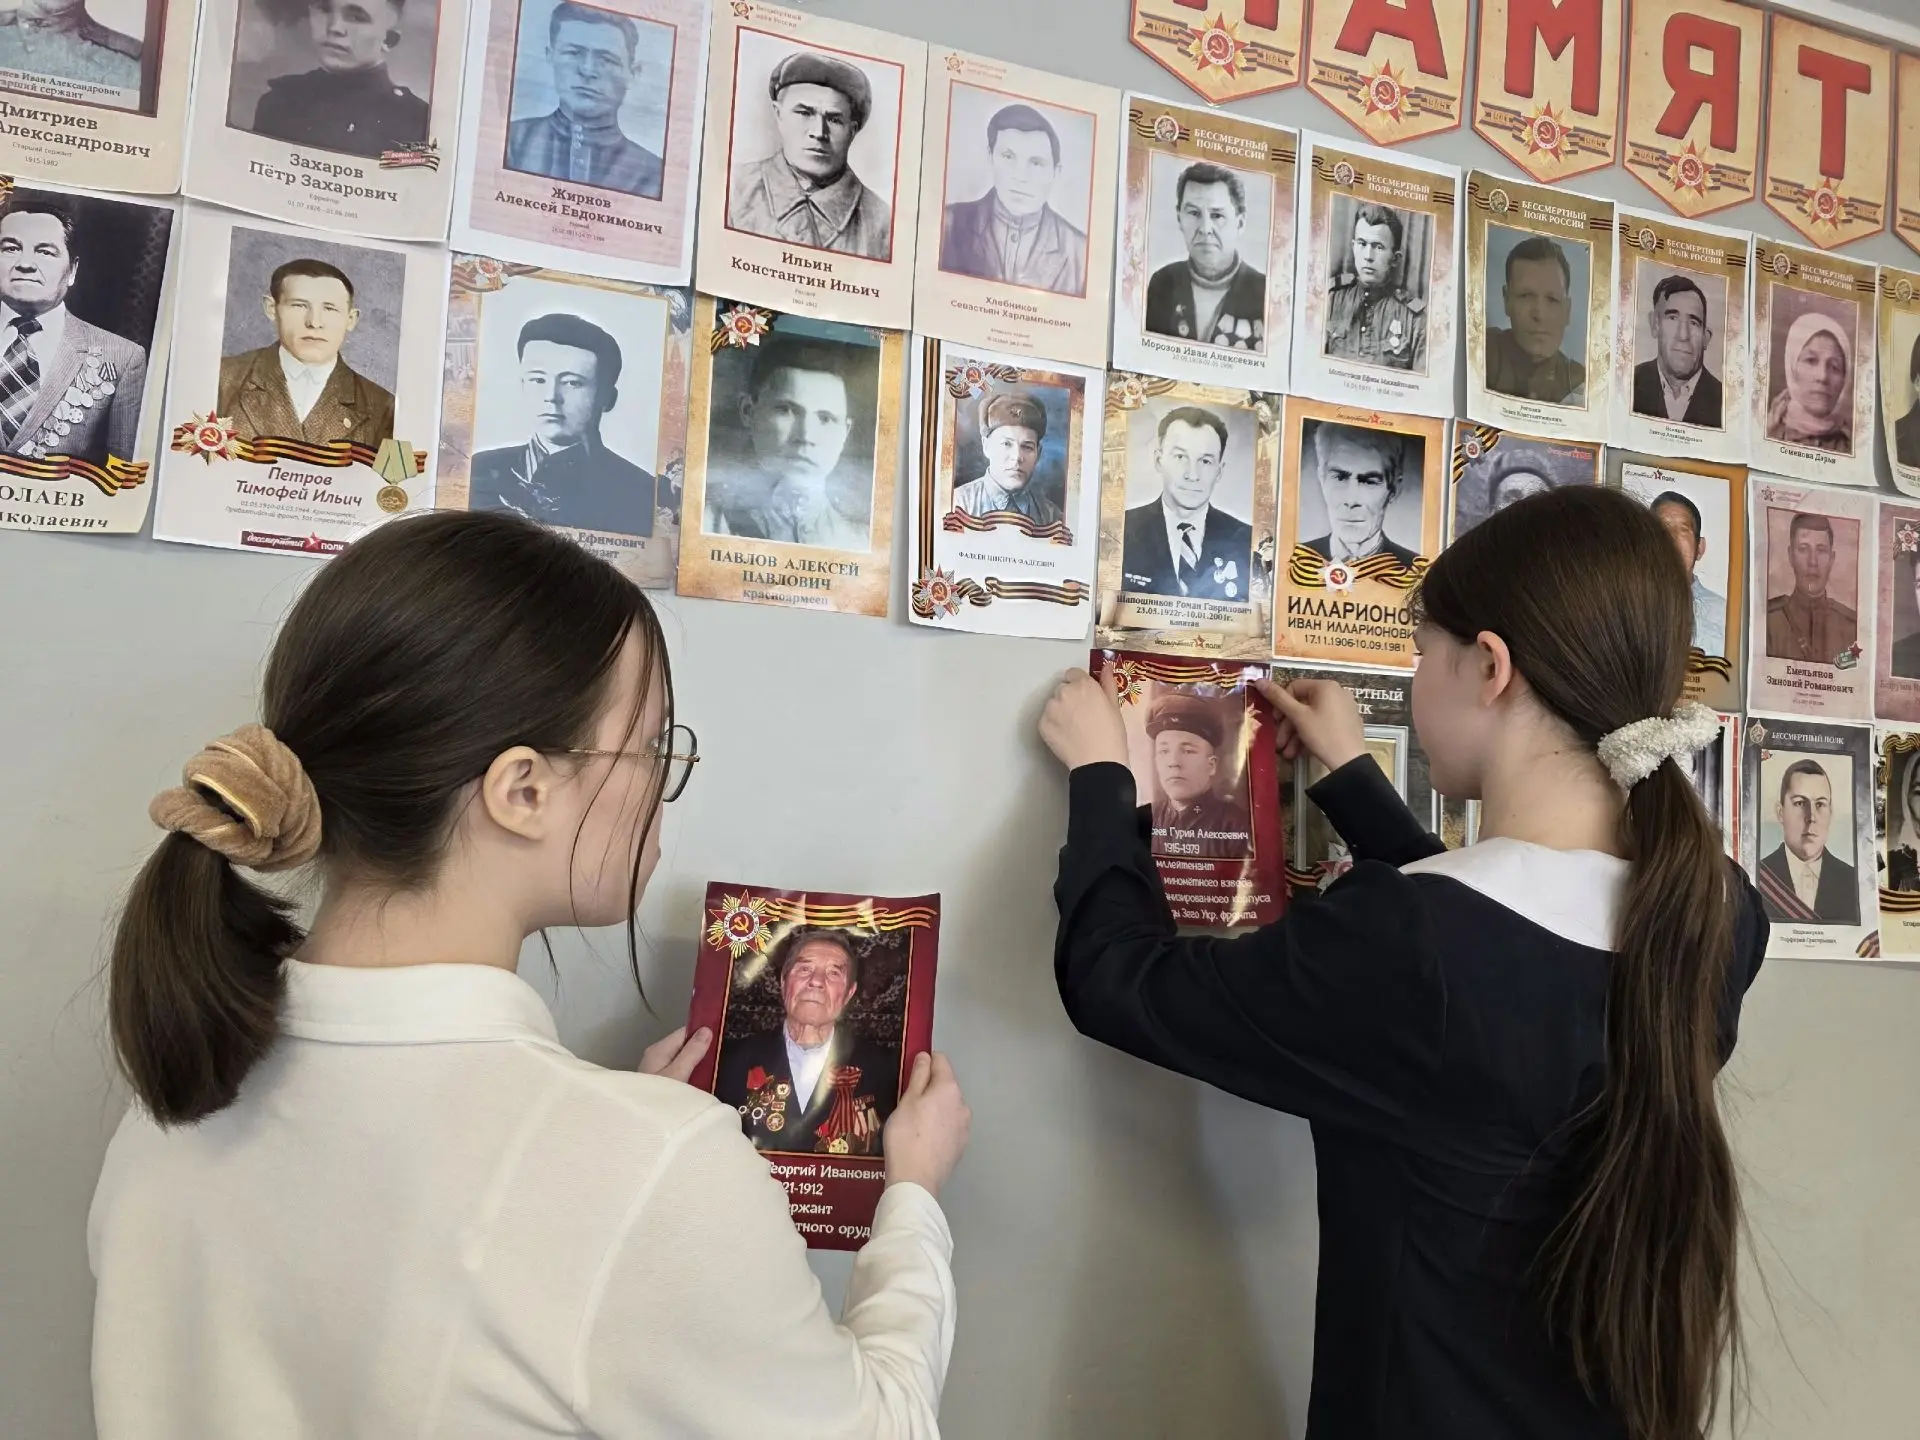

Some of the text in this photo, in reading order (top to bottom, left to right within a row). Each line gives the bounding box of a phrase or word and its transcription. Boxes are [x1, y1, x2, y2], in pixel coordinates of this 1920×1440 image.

[0, 79, 83, 99] арший сержант
[22, 72, 46, 84] Иван
[49, 78, 120, 97] Александрович
[0, 101, 98, 130] Дмитриев
[12, 141, 72, 158] Старший сержант
[1194, 128, 1268, 152] БЕССМЕРТНЫЙ
[1196, 139, 1265, 160] ПОЛК РОССИИ
[289, 153, 364, 179] Захаров
[249, 160, 400, 202] Пётр Захарович
[1366, 173, 1430, 194] БЕССМЕРТНЫЙ
[552, 187, 611, 209] Жирнов
[1368, 183, 1428, 203] ПОЛК РОССИИ
[495, 190, 557, 214] Алексей
[561, 205, 663, 235] Евдокимович
[1521, 200, 1587, 221] БЕССМЕРТНЫЙ
[1524, 211, 1585, 230] ПОЛК РОССИИ
[1666, 239, 1724, 257] БЕССМЕРТНЫЙ
[1669, 248, 1722, 265] ПОЛК РОССИИ
[782, 251, 832, 273] Ильин
[731, 256, 880, 298] Константин Ильич
[1800, 264, 1855, 283] БЕССМЕРТНЫЙ
[1802, 273, 1852, 291] ПОЛК РОССИИ
[950, 299, 1000, 316] Севастьян
[985, 296, 1038, 313] Хлебников
[1141, 338, 1181, 354] Морозов
[1184, 347, 1208, 359] Иван
[1210, 352, 1265, 368] Алексеевич
[268, 466, 333, 486] Петров
[0, 485, 84, 507] ОЛАЕВ
[236, 479, 363, 507] Тимофей Ильич
[0, 511, 108, 528] колаевич
[578, 531, 646, 549] Ефимович
[710, 549, 860, 577] ПАВЛОВ АЛЕКСЕЙ
[742, 570, 832, 591] ПАВЛОВИЧ
[743, 589, 828, 605] красноармеец
[1117, 595, 1252, 615] Шапошников Роман Гаврилович
[1169, 619, 1200, 628] капитан
[1288, 617, 1415, 640] ИВАН ИЛЛАРИОНОВИ
[1304, 634, 1406, 652] 17.11.1906-10.09.1981
[1786, 665, 1834, 679] Емельянов
[1766, 675, 1803, 689] Зиновий
[1804, 682, 1853, 694] Романович
[1170, 827, 1195, 839] Гурий
[1197, 828, 1249, 840] Алексеевич
[1163, 842, 1201, 854] 1915-1979
[1164, 876, 1219, 888] миномётного
[820, 1165, 886, 1180] Иванович
[781, 1182, 824, 1196] 21-1912
[788, 1203, 833, 1216] ржант
[838, 1225, 872, 1240] оруд
